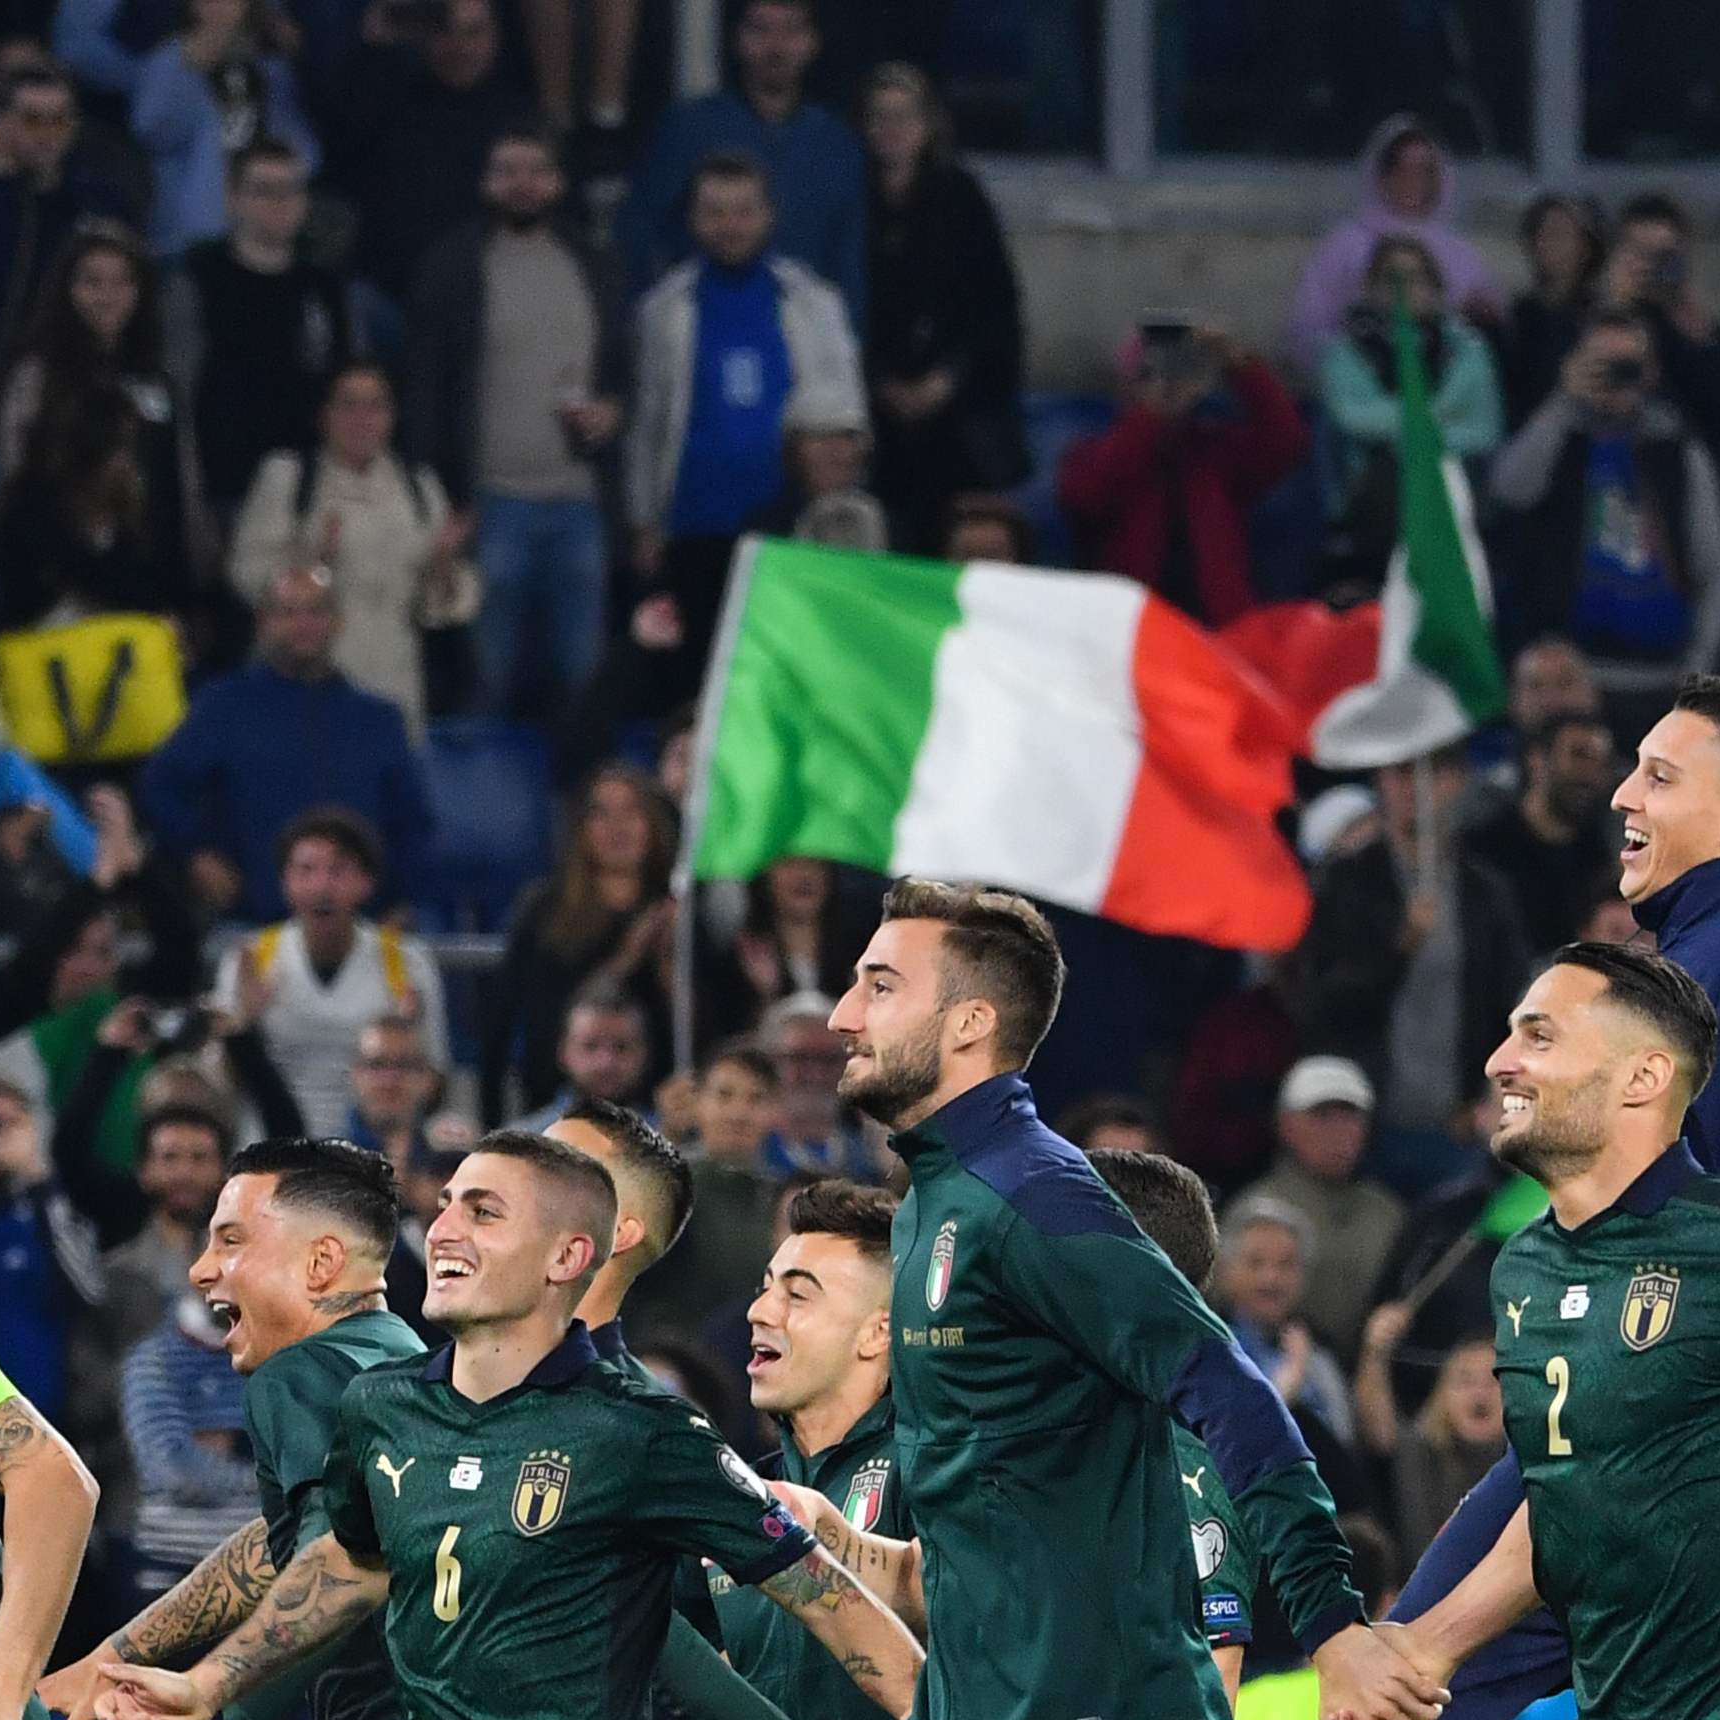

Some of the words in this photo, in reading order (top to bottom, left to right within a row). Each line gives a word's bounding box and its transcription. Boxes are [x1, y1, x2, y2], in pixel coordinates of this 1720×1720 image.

[1632, 1280, 1674, 1295] ITALIA
[1545, 1355, 1573, 1456] 2
[524, 1466, 565, 1483] ITALIA
[433, 1525, 462, 1622] 6
[1201, 1600, 1239, 1617] ESPECT
